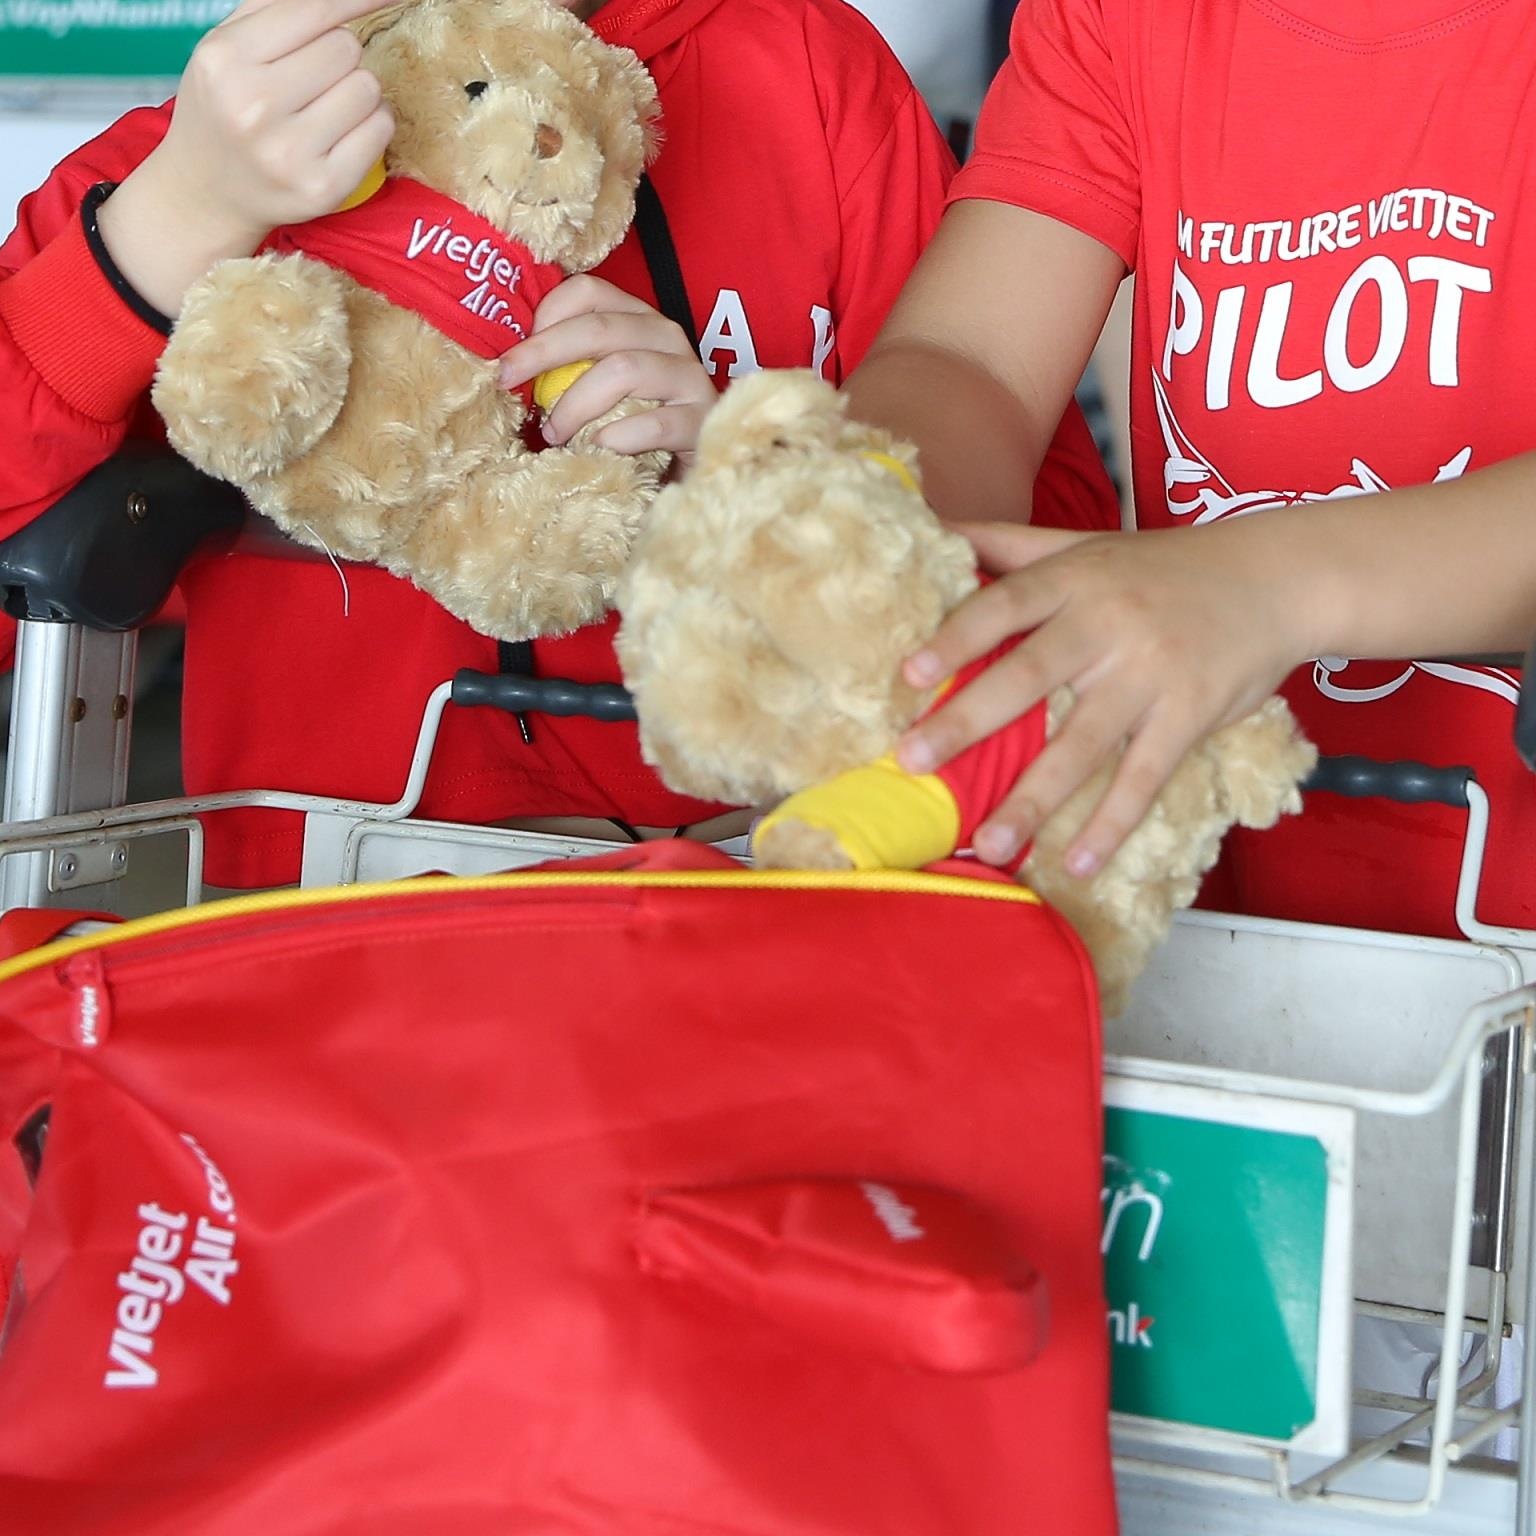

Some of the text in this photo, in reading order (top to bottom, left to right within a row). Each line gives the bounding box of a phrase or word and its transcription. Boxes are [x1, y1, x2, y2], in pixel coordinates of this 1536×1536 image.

[1200, 204, 1362, 265] FUTURE
[1368, 188, 1496, 247] VIETJET
[1162, 254, 1493, 411] PILOT
